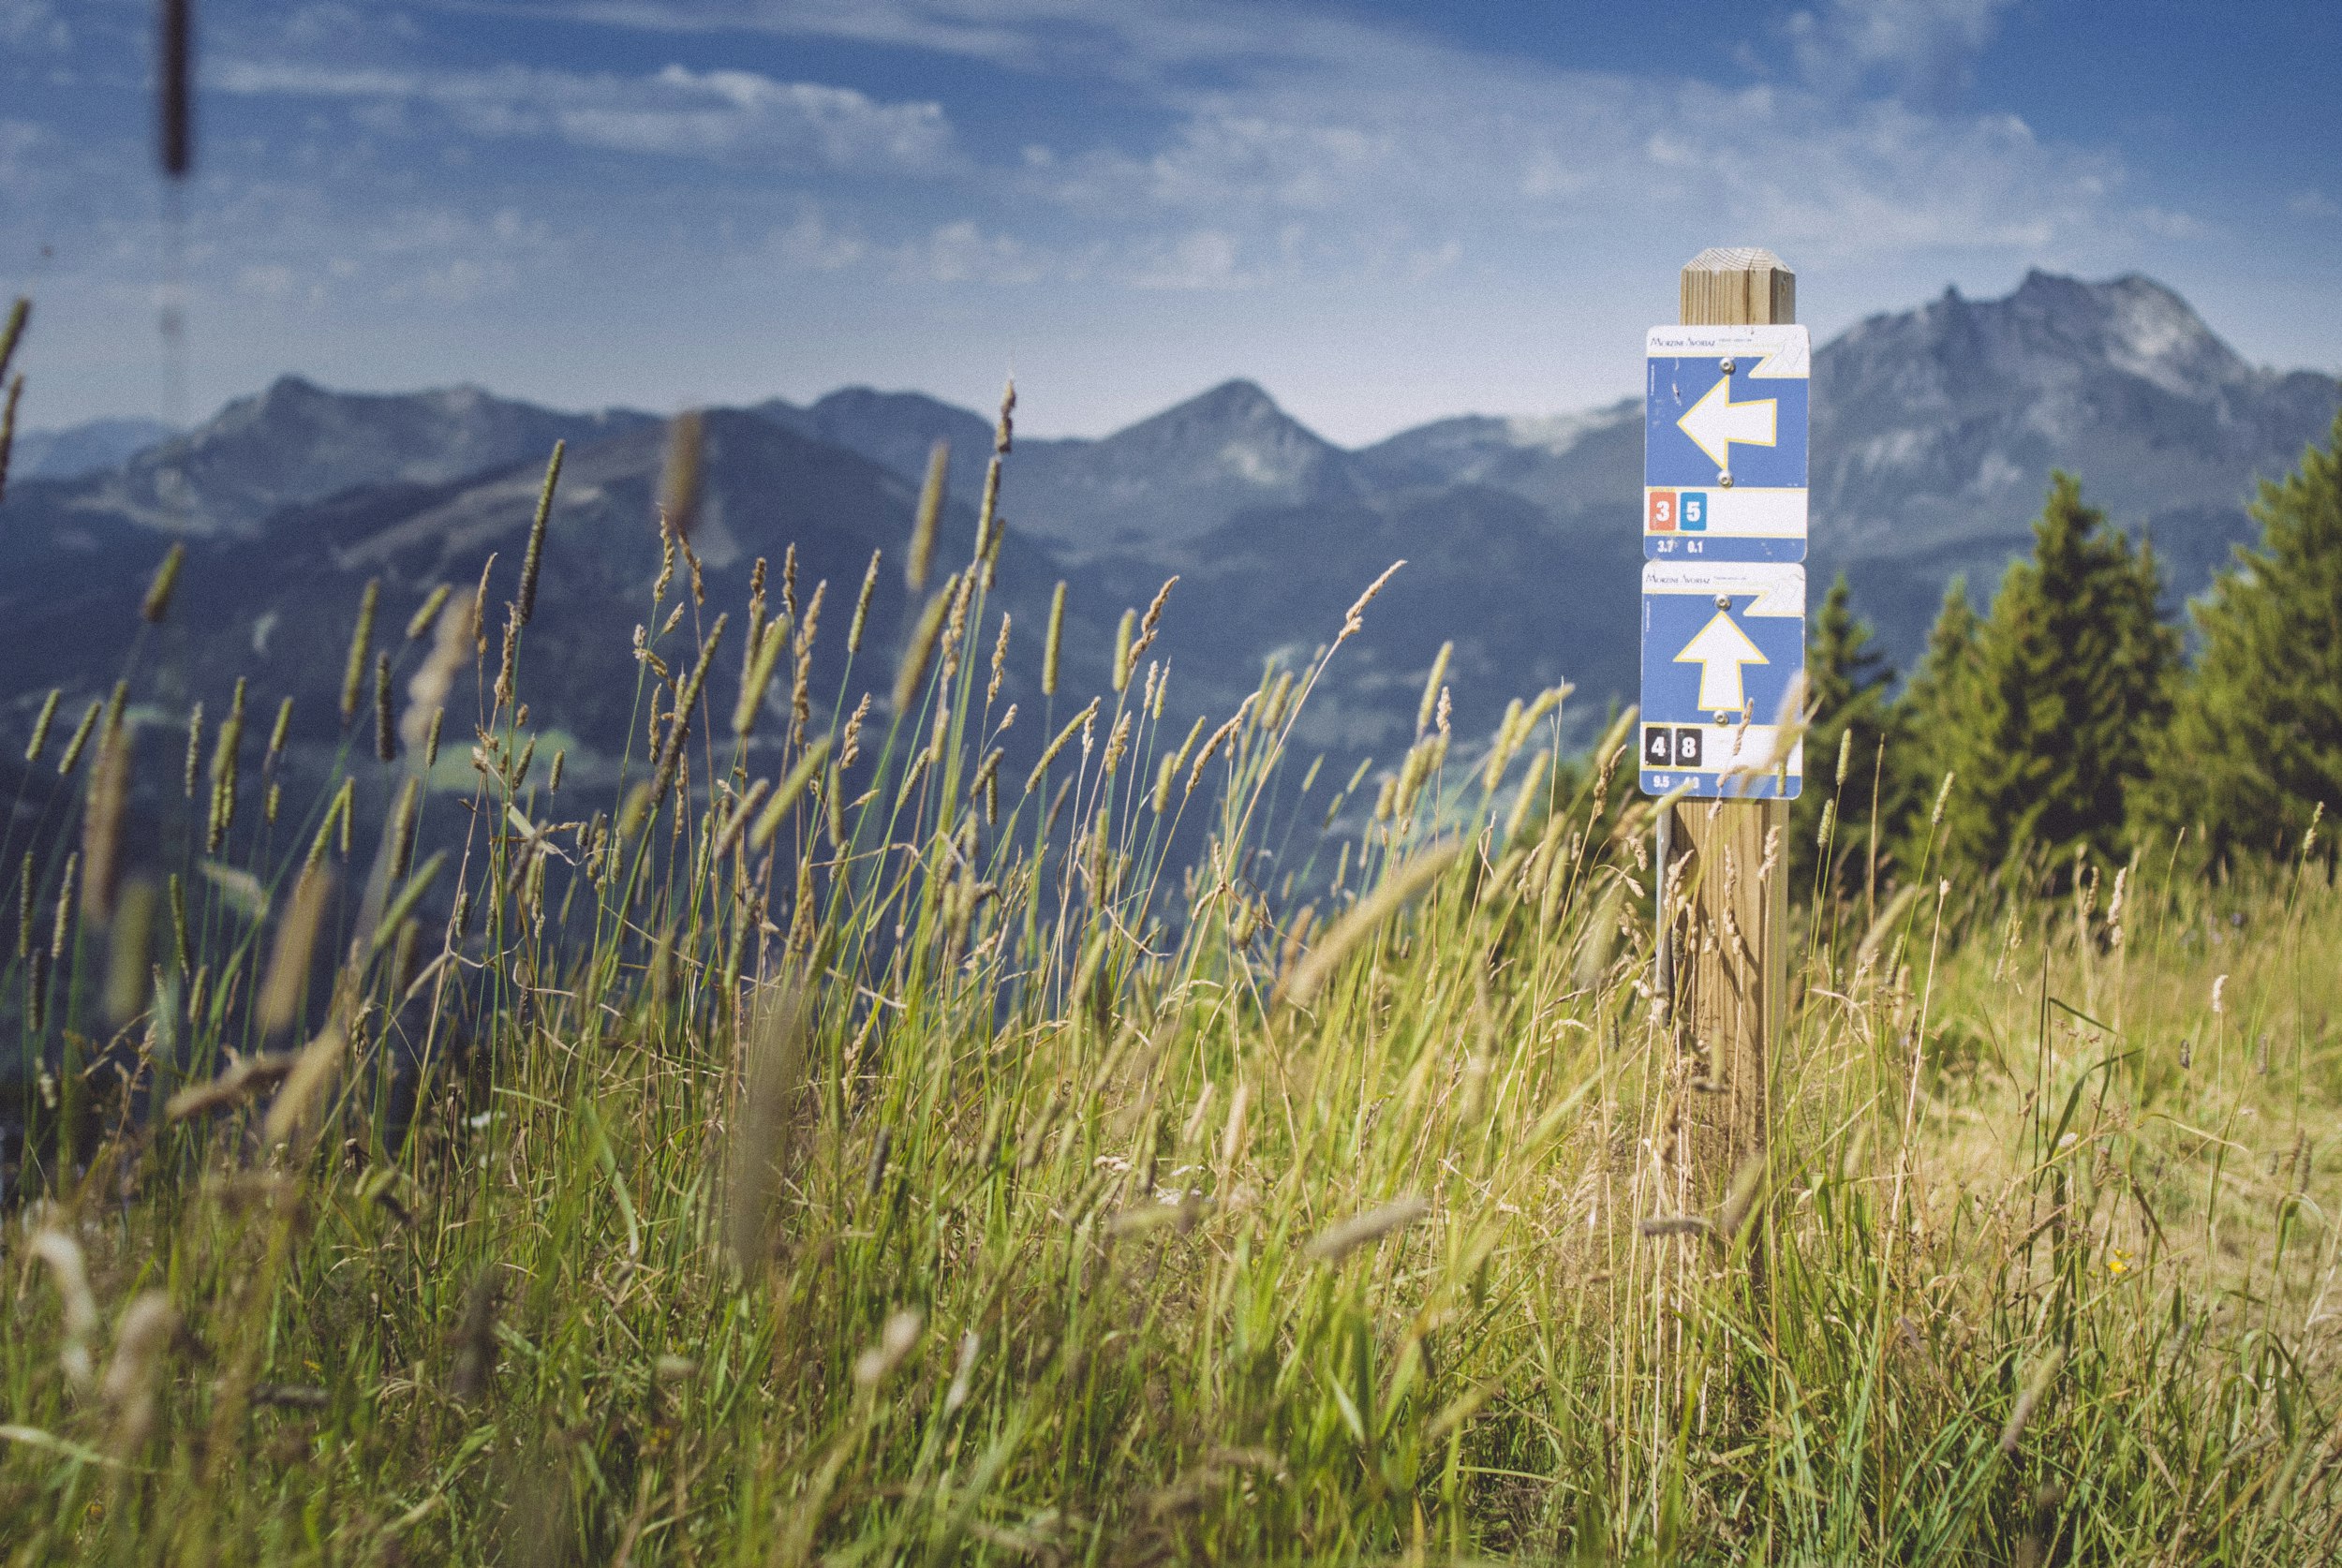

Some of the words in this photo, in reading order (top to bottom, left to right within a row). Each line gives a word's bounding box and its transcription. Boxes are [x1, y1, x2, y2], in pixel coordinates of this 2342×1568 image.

[1655, 500, 1669, 522] 3
[1686, 501, 1700, 522] 5
[1651, 736, 1666, 757] 4
[1682, 736, 1696, 758] 8
